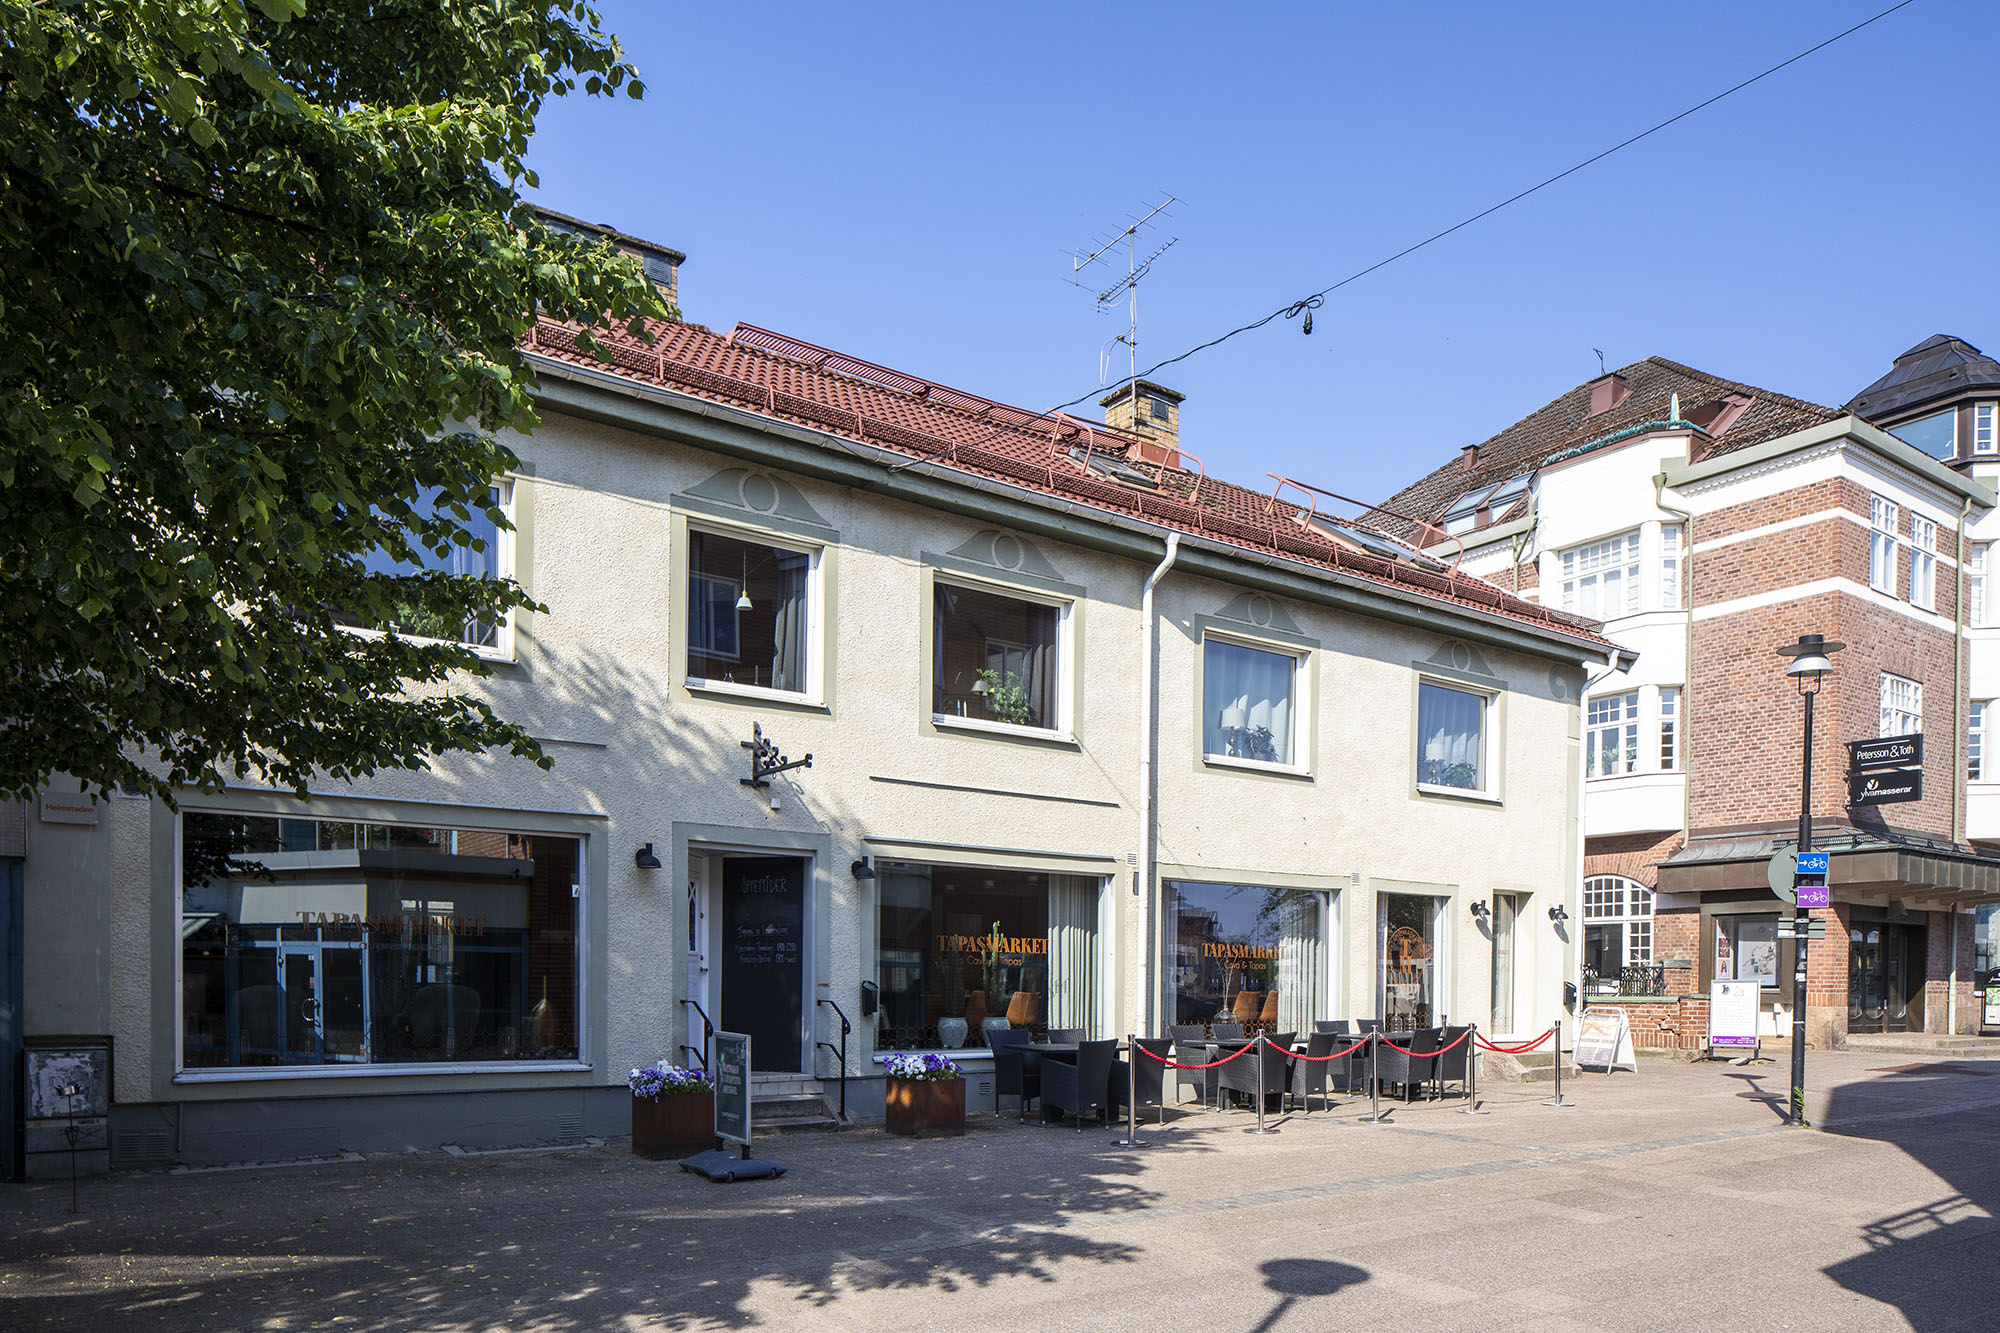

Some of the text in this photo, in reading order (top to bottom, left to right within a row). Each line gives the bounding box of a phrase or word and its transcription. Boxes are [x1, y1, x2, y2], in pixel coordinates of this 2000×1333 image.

[1857, 744, 1914, 760] Petersson & Toth
[296, 911, 488, 937] TAPASMARKET
[936, 935, 1048, 954] TAPASMARKET
[1201, 942, 1287, 960] TAPASMARKET
[1249, 960, 1266, 970] Tapas
